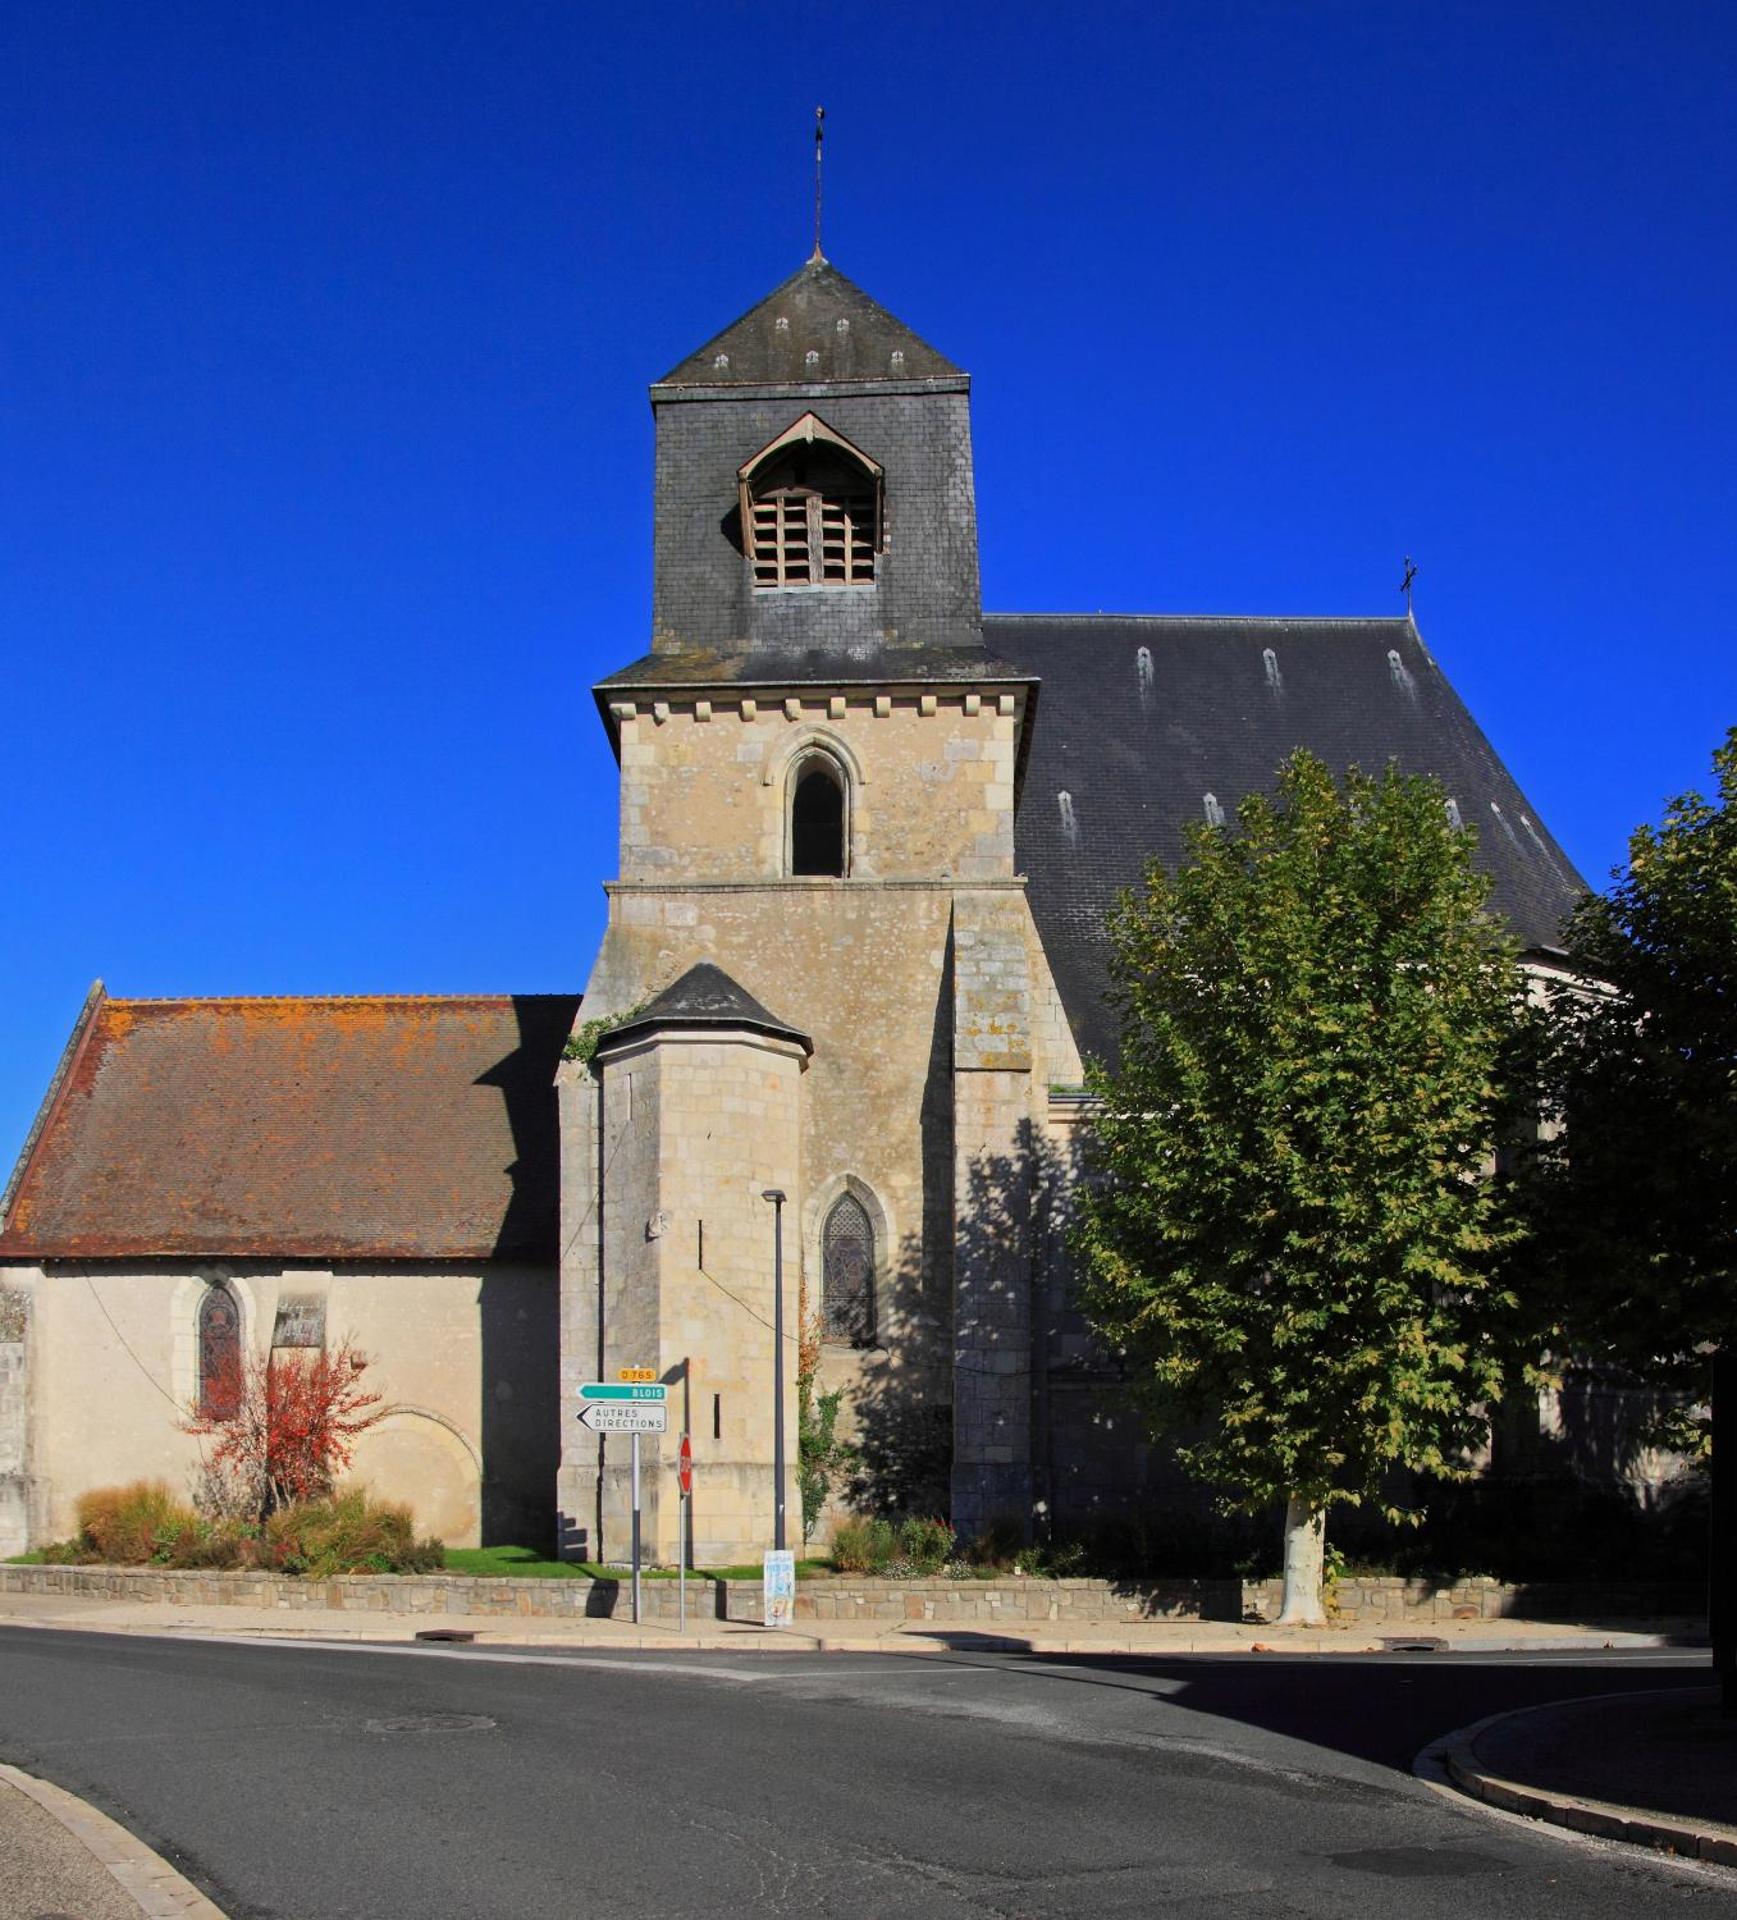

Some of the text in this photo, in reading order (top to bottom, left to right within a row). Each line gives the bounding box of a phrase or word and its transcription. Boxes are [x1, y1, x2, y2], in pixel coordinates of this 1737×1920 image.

[632, 1370, 653, 1379] 765
[632, 1388, 663, 1398] BLOIS
[595, 1408, 638, 1418] AUTRES
[595, 1418, 663, 1428] DIRECTIONS
